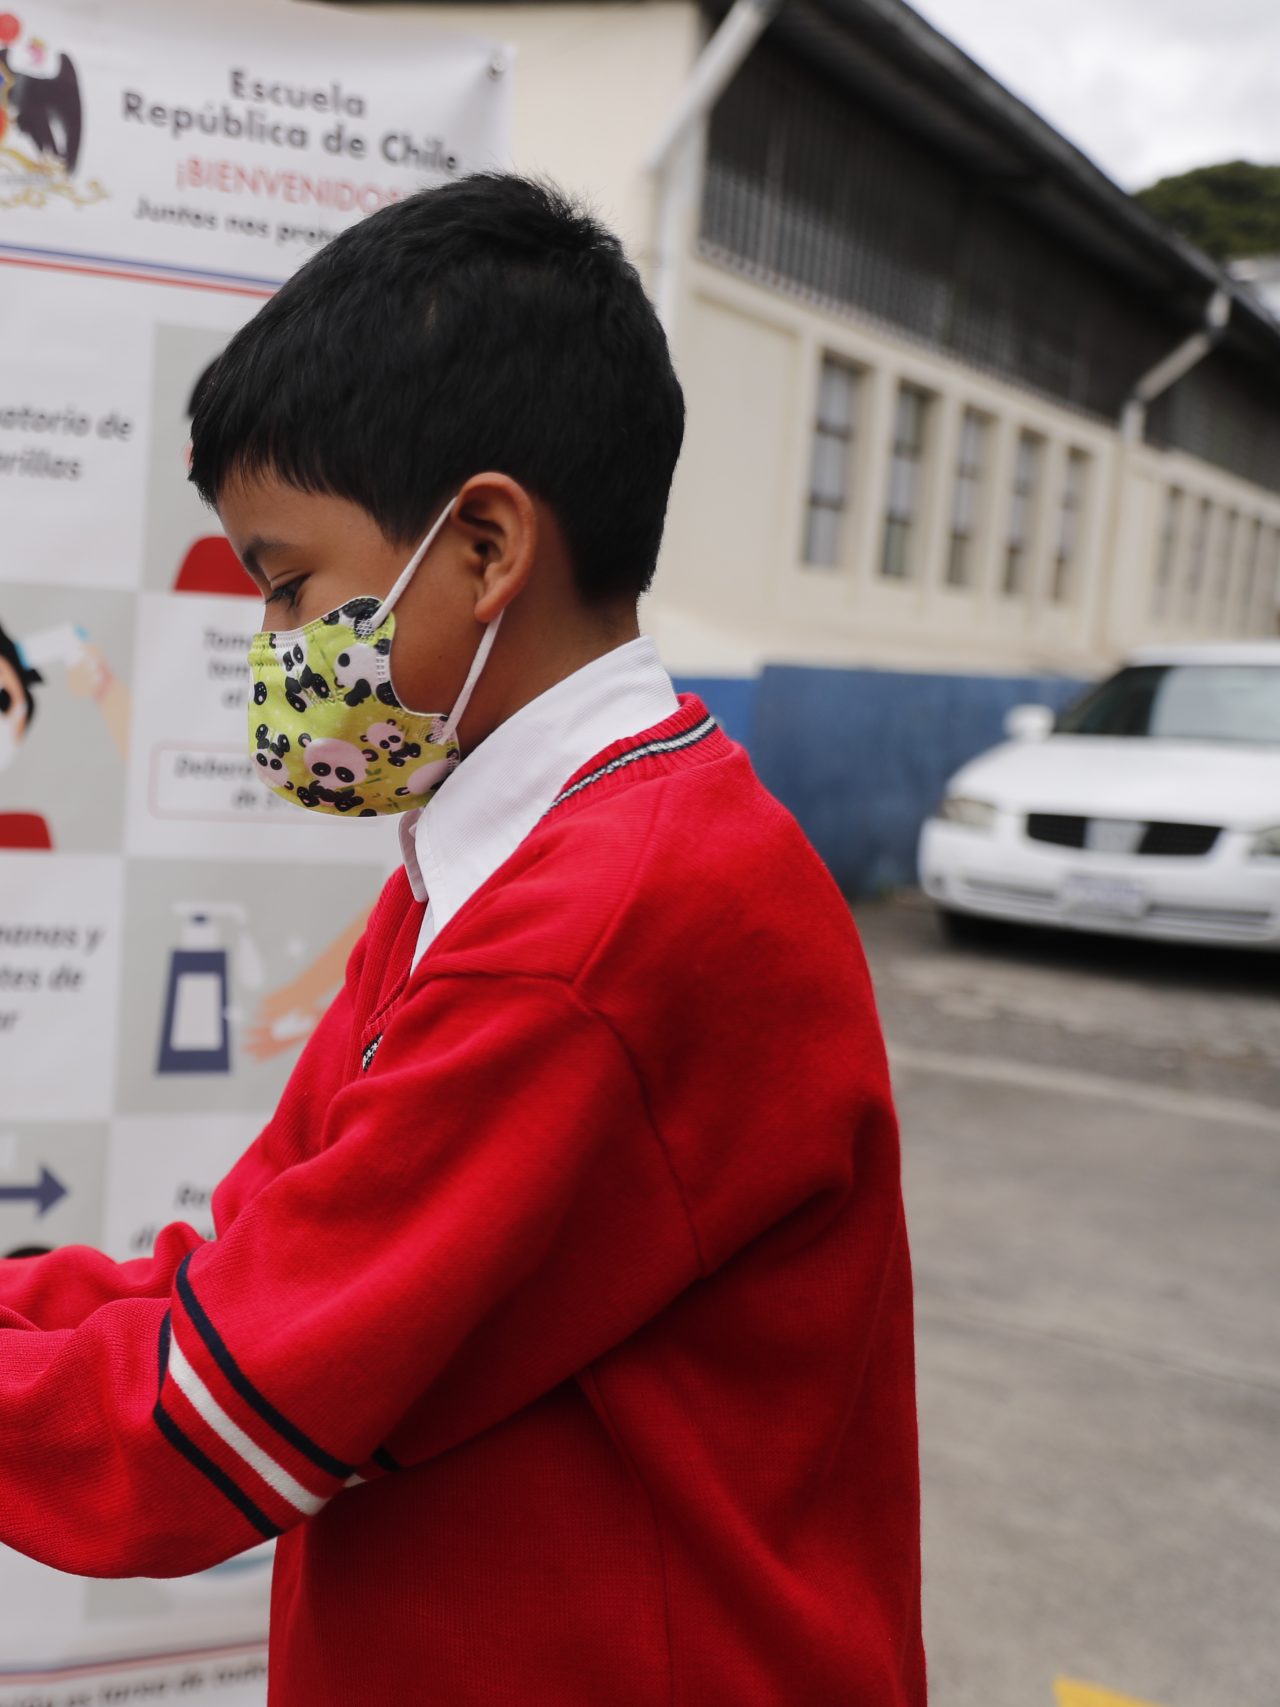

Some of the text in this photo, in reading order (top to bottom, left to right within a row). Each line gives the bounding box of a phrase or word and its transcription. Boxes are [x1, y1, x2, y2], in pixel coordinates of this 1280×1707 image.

[231, 68, 366, 118] Escuela
[123, 92, 458, 170] República de Chile
[135, 198, 218, 231] Juntos
[97, 410, 132, 441] de
[82, 923, 104, 956] y
[48, 960, 83, 991] de
